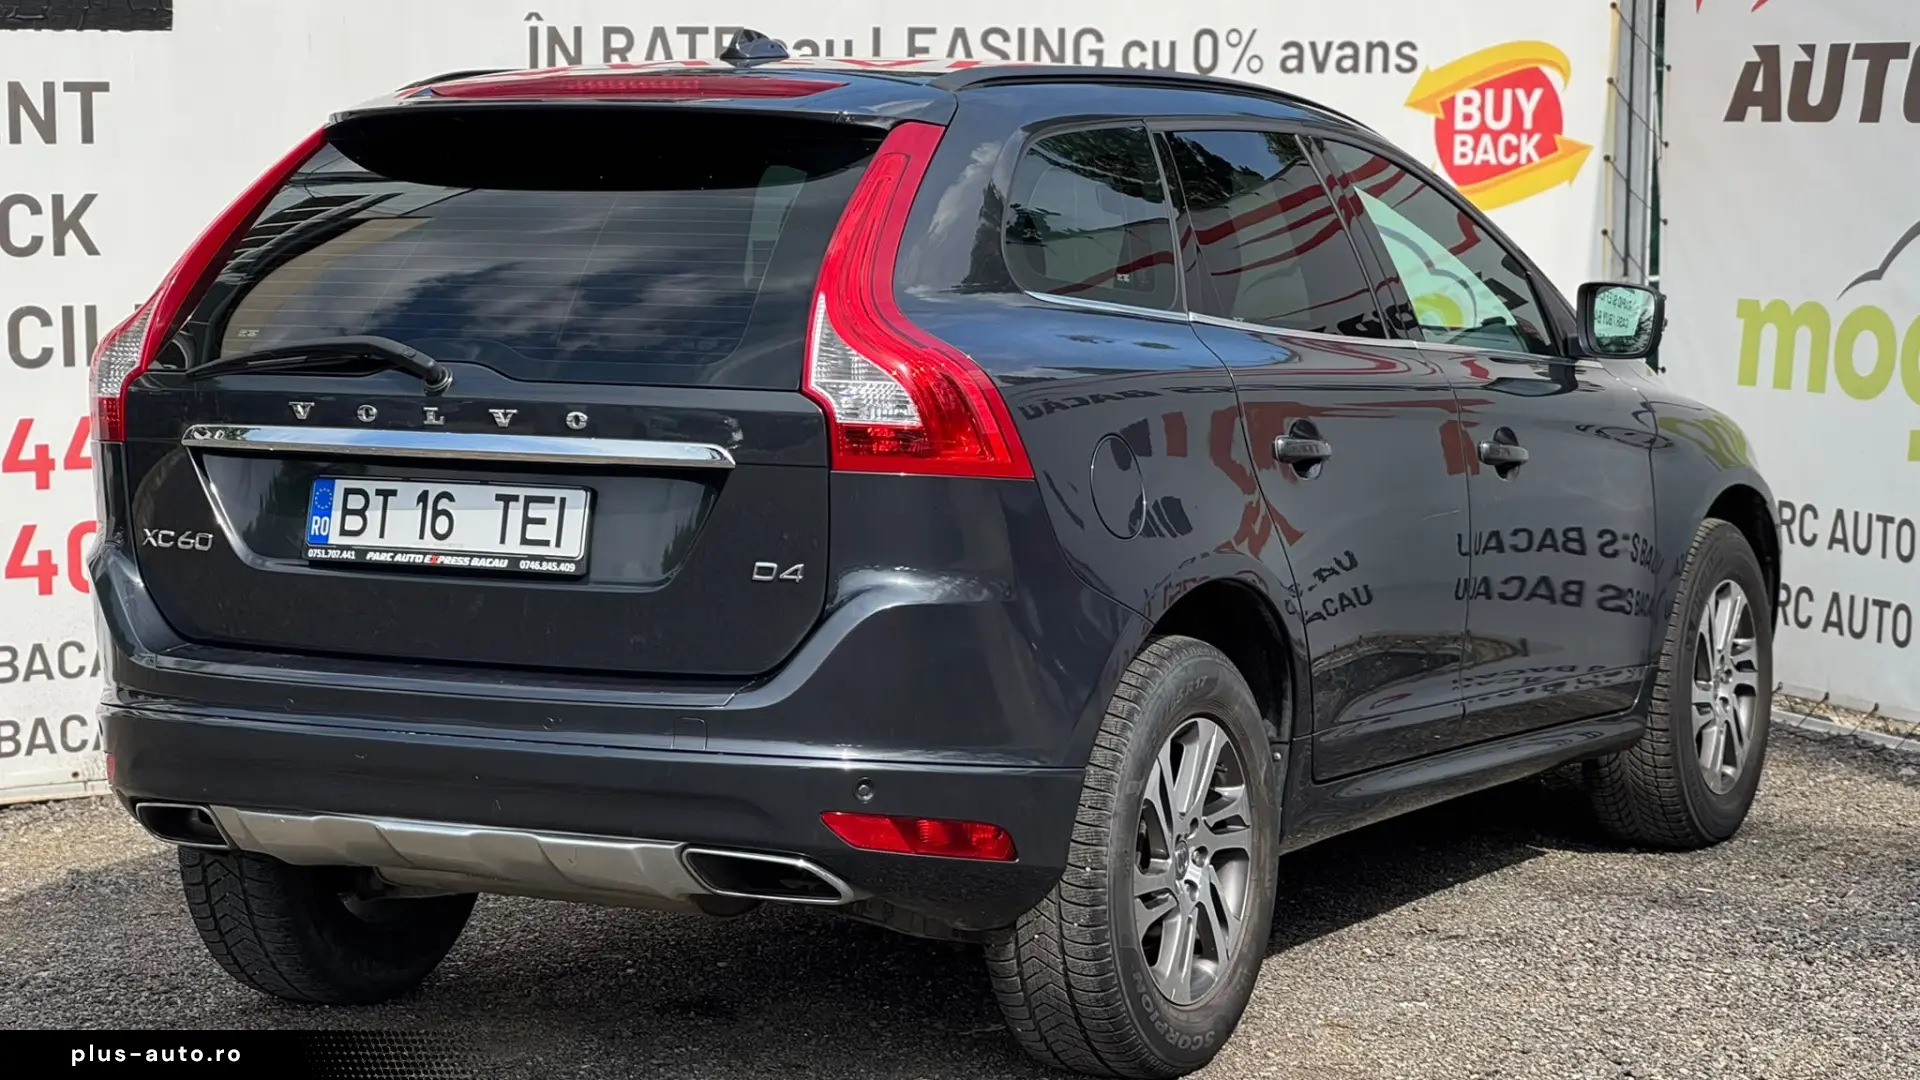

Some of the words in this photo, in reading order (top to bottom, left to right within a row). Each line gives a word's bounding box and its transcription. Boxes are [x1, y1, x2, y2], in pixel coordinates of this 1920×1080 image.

[524, 12, 583, 68] ÎN
[872, 26, 1104, 66] LEASING
[1122, 39, 1177, 72] cu
[1193, 28, 1264, 74] 0%
[1279, 40, 1419, 74] avans
[1453, 87, 1545, 131] BUY
[1453, 133, 1543, 166] BACK
[288, 401, 589, 430] VOLVO
[310, 515, 331, 536] RO
[338, 487, 398, 539] BT
[415, 489, 456, 541] 16
[494, 492, 567, 548] TEI
[1826, 508, 1916, 563] AUTO
[142, 528, 214, 552] XC60
[308, 548, 356, 561] 0751.707.441
[366, 551, 393, 562] PARC
[393, 553, 424, 565] AUTO
[424, 554, 470, 567] EXPRESS
[470, 557, 509, 568] BACAU
[519, 559, 576, 573] 0746.845.409
[752, 561, 805, 582] D4
[1821, 591, 1912, 650] AUTO
[0, 714, 102, 758] BAC
[1132, 971, 1216, 1051] SCORPION
